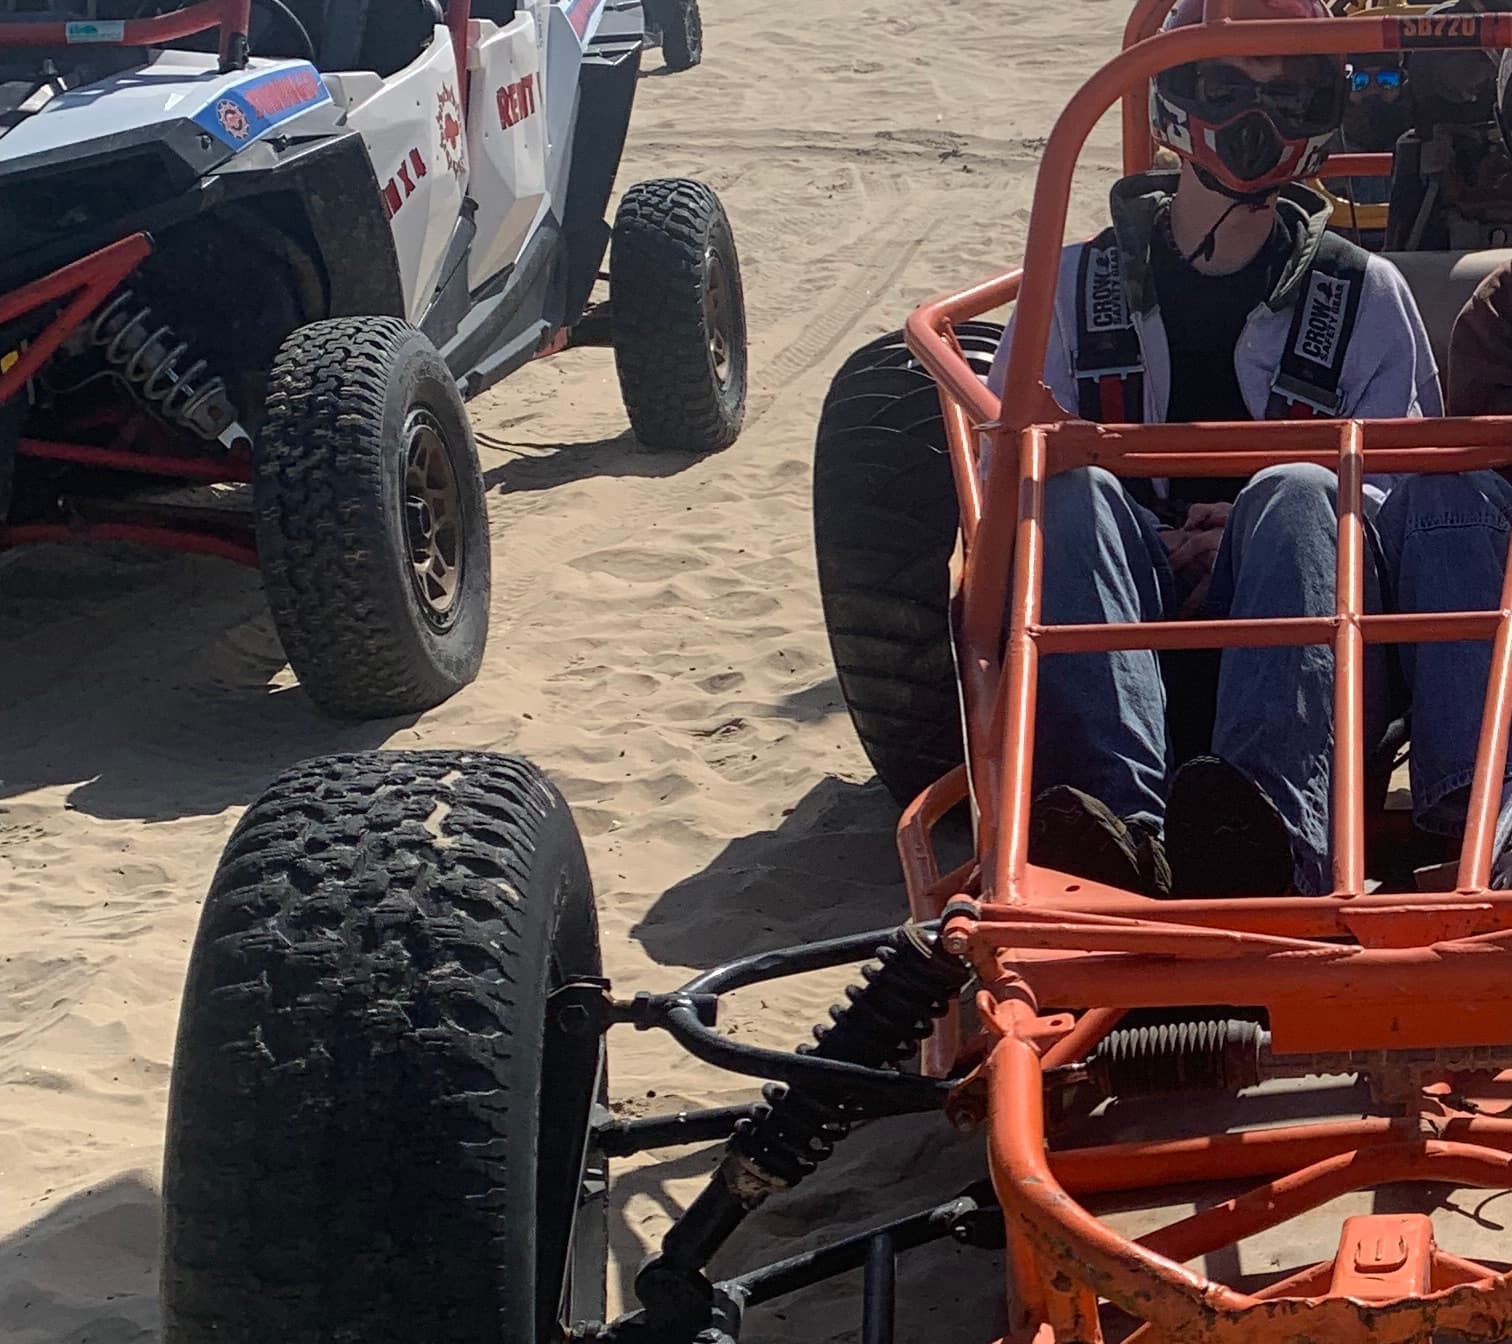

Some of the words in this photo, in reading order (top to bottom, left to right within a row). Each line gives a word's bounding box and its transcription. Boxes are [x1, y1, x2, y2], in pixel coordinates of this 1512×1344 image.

[1092, 271, 1113, 327] CROW
[1302, 297, 1331, 358] CROW
[1320, 316, 1338, 362] SAFETY
